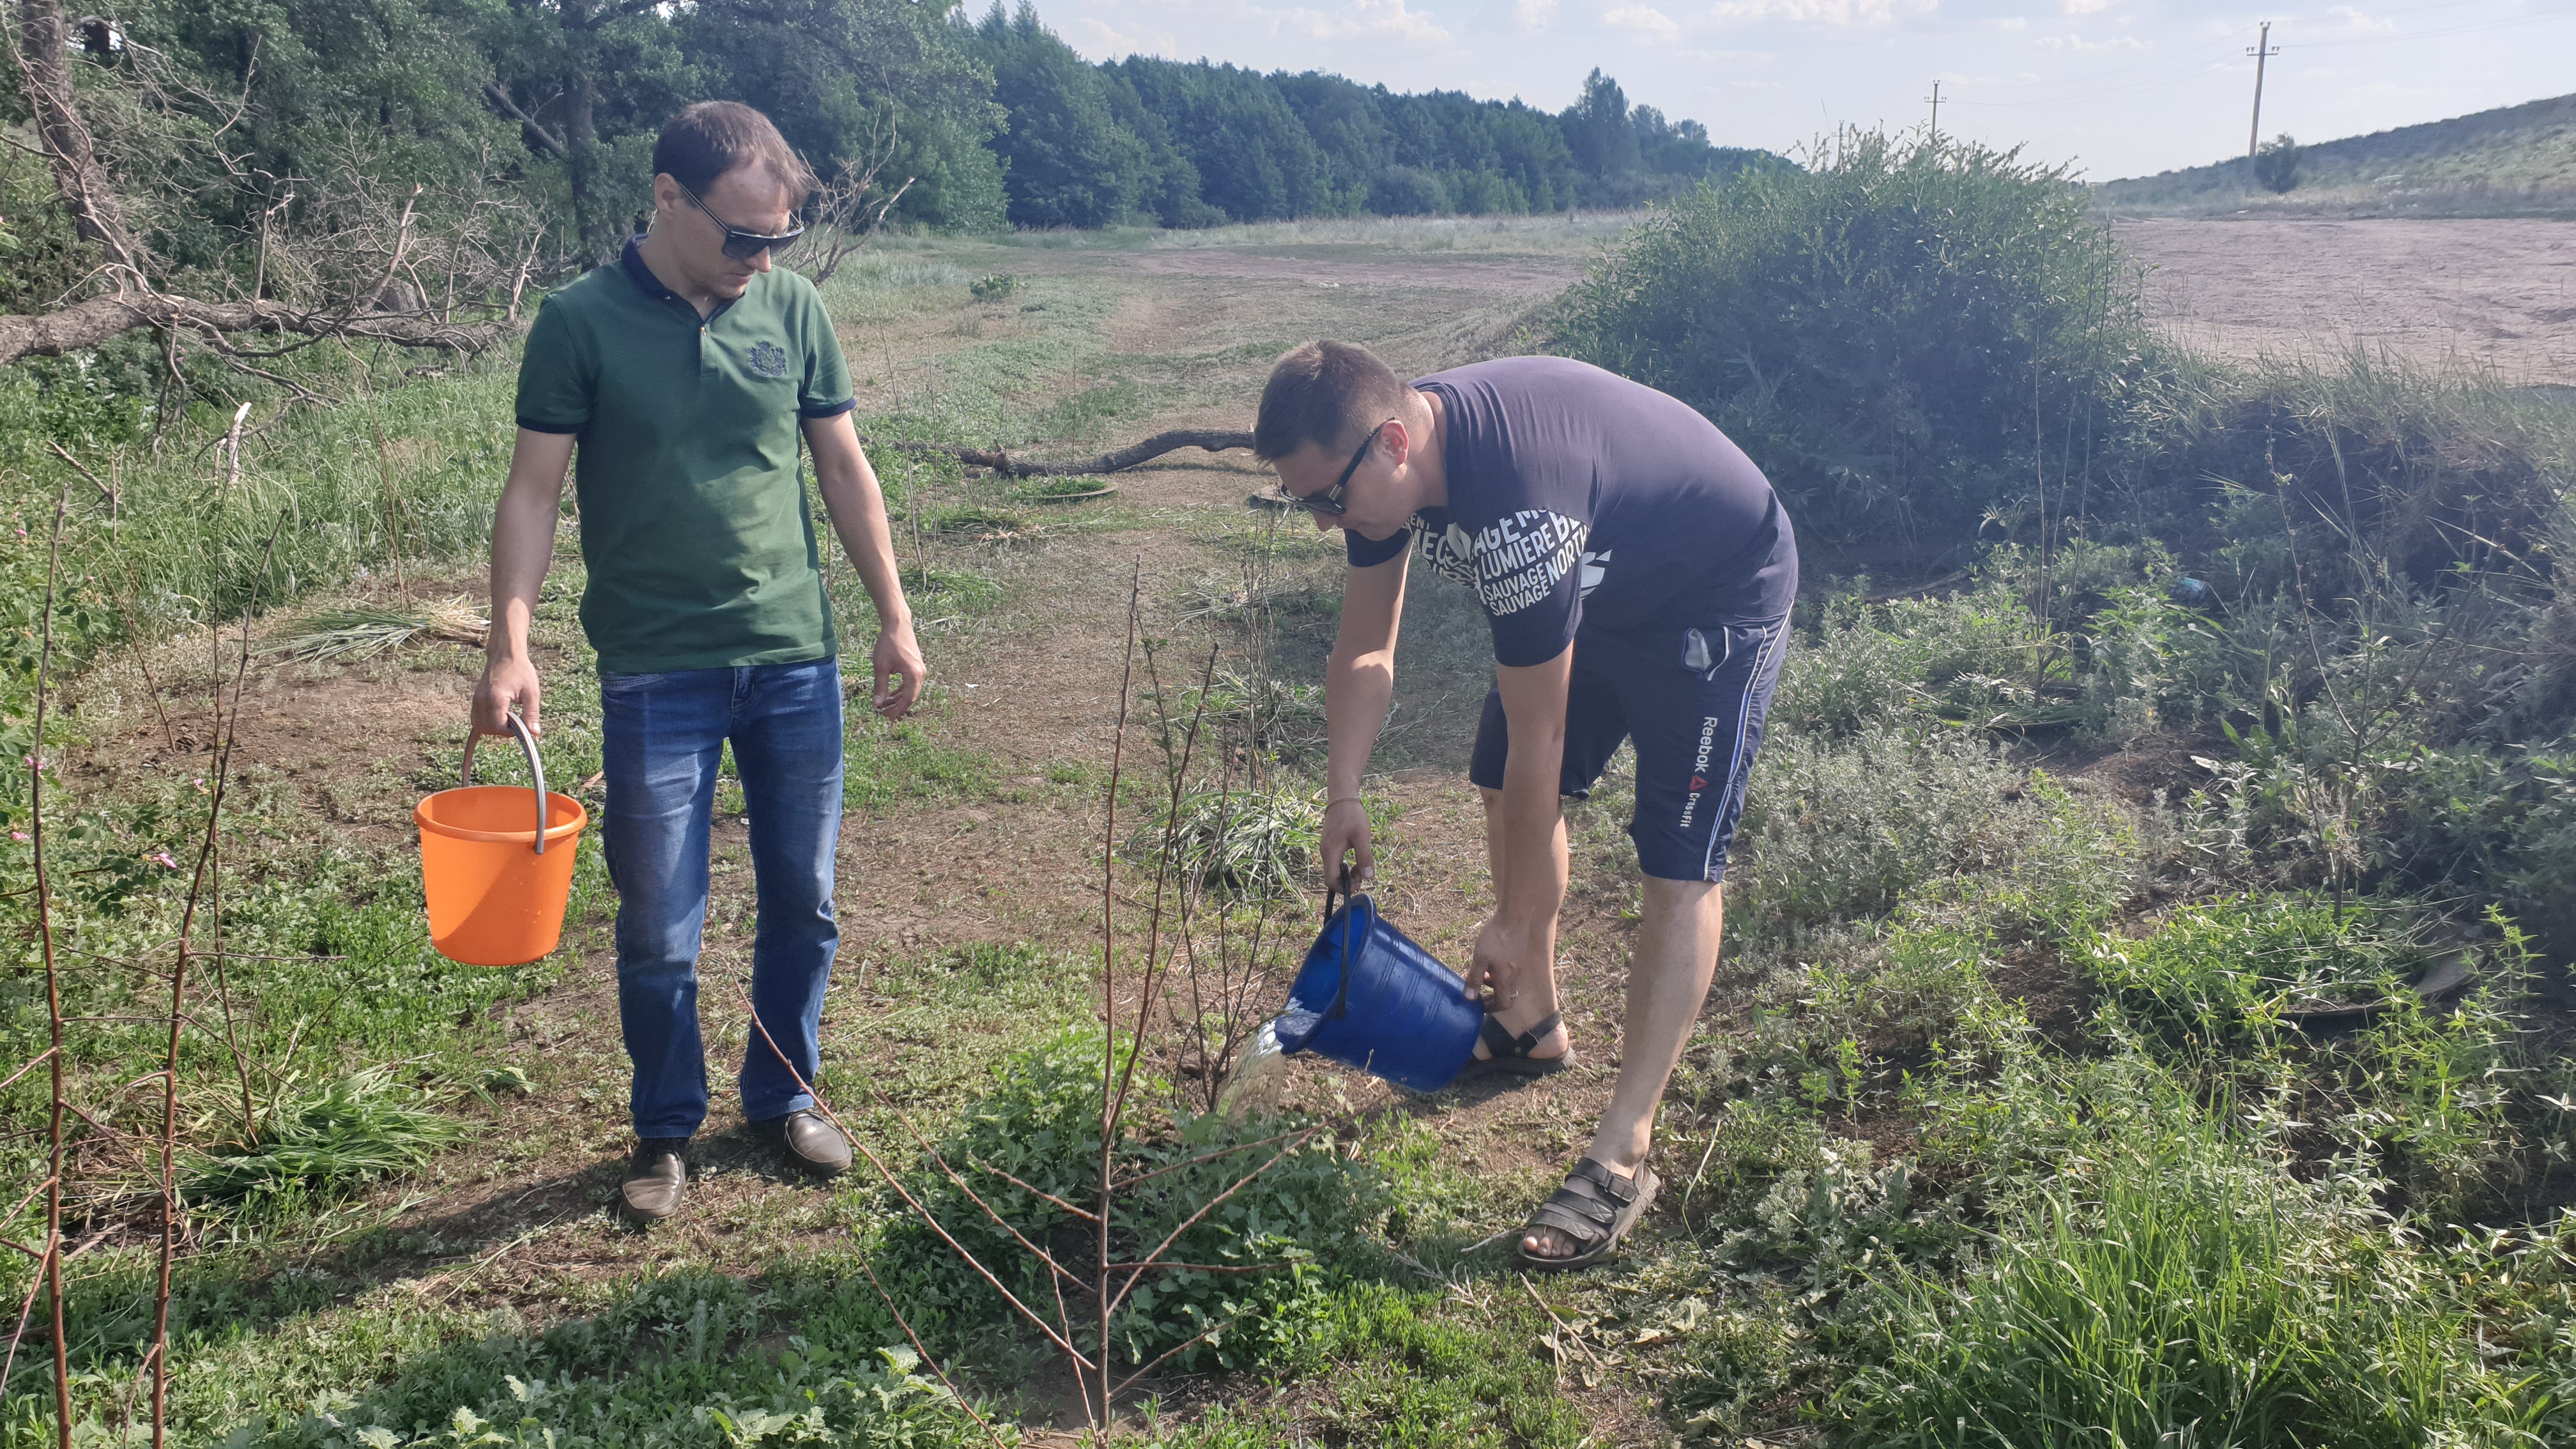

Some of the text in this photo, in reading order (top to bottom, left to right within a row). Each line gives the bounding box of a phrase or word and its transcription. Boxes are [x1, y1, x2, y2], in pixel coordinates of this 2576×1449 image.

[1481, 522, 1556, 580] LUMIERE
[1483, 562, 1547, 601] SAUVAGE
[1489, 578, 1551, 617] SAUVAGE
[1694, 716, 1718, 773] Reebok
[1680, 792, 1701, 828] CrossFit
